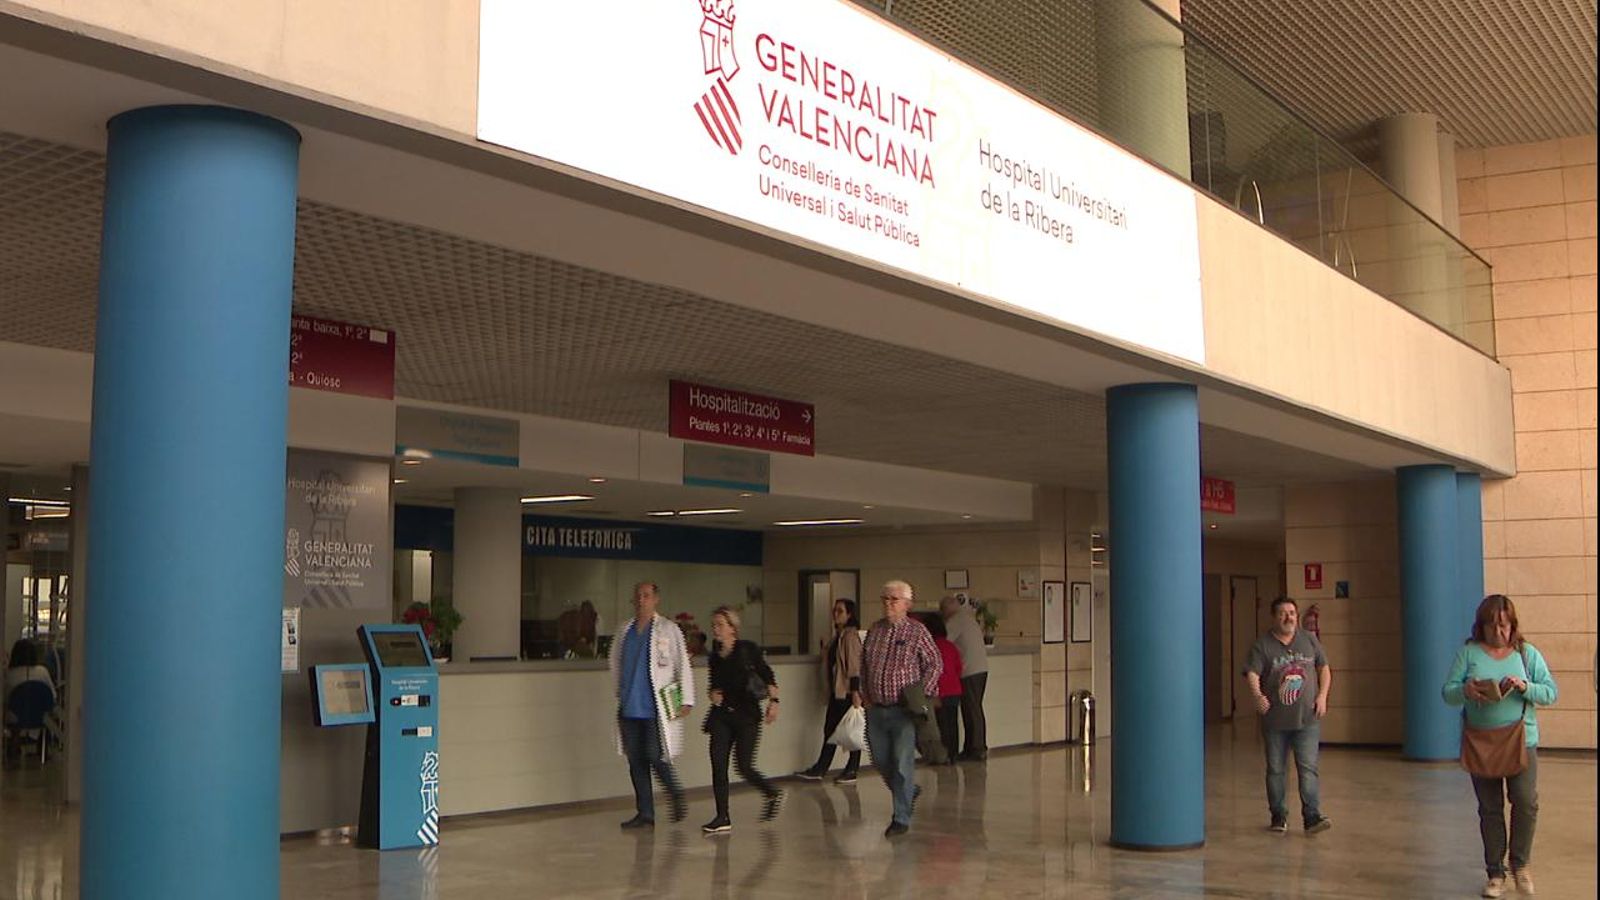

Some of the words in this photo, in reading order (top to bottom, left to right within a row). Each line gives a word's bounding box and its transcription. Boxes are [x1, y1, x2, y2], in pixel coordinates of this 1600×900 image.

[756, 33, 937, 141] GENERALITAT
[759, 82, 935, 189] VALENCIANA
[758, 144, 841, 191] Conselleria
[845, 176, 861, 198] de
[864, 184, 909, 216] Sanitat
[979, 137, 1046, 193] Hospital
[1050, 172, 1128, 230] Universitari
[759, 173, 826, 216] Universal
[830, 199, 834, 218] i
[838, 202, 871, 231] Salut
[874, 214, 920, 247] Pública
[981, 183, 1003, 214] de
[1007, 191, 1020, 222] la
[1025, 200, 1073, 243] Ribera
[307, 371, 341, 388] Quiosc
[689, 386, 781, 420] Hospitalització
[689, 415, 720, 433] Plantes
[304, 540, 375, 554] GENERALITAT
[304, 554, 372, 568] VALENCIANA
[526, 526, 555, 546] CITA
[558, 527, 632, 551] TELEFONICA
